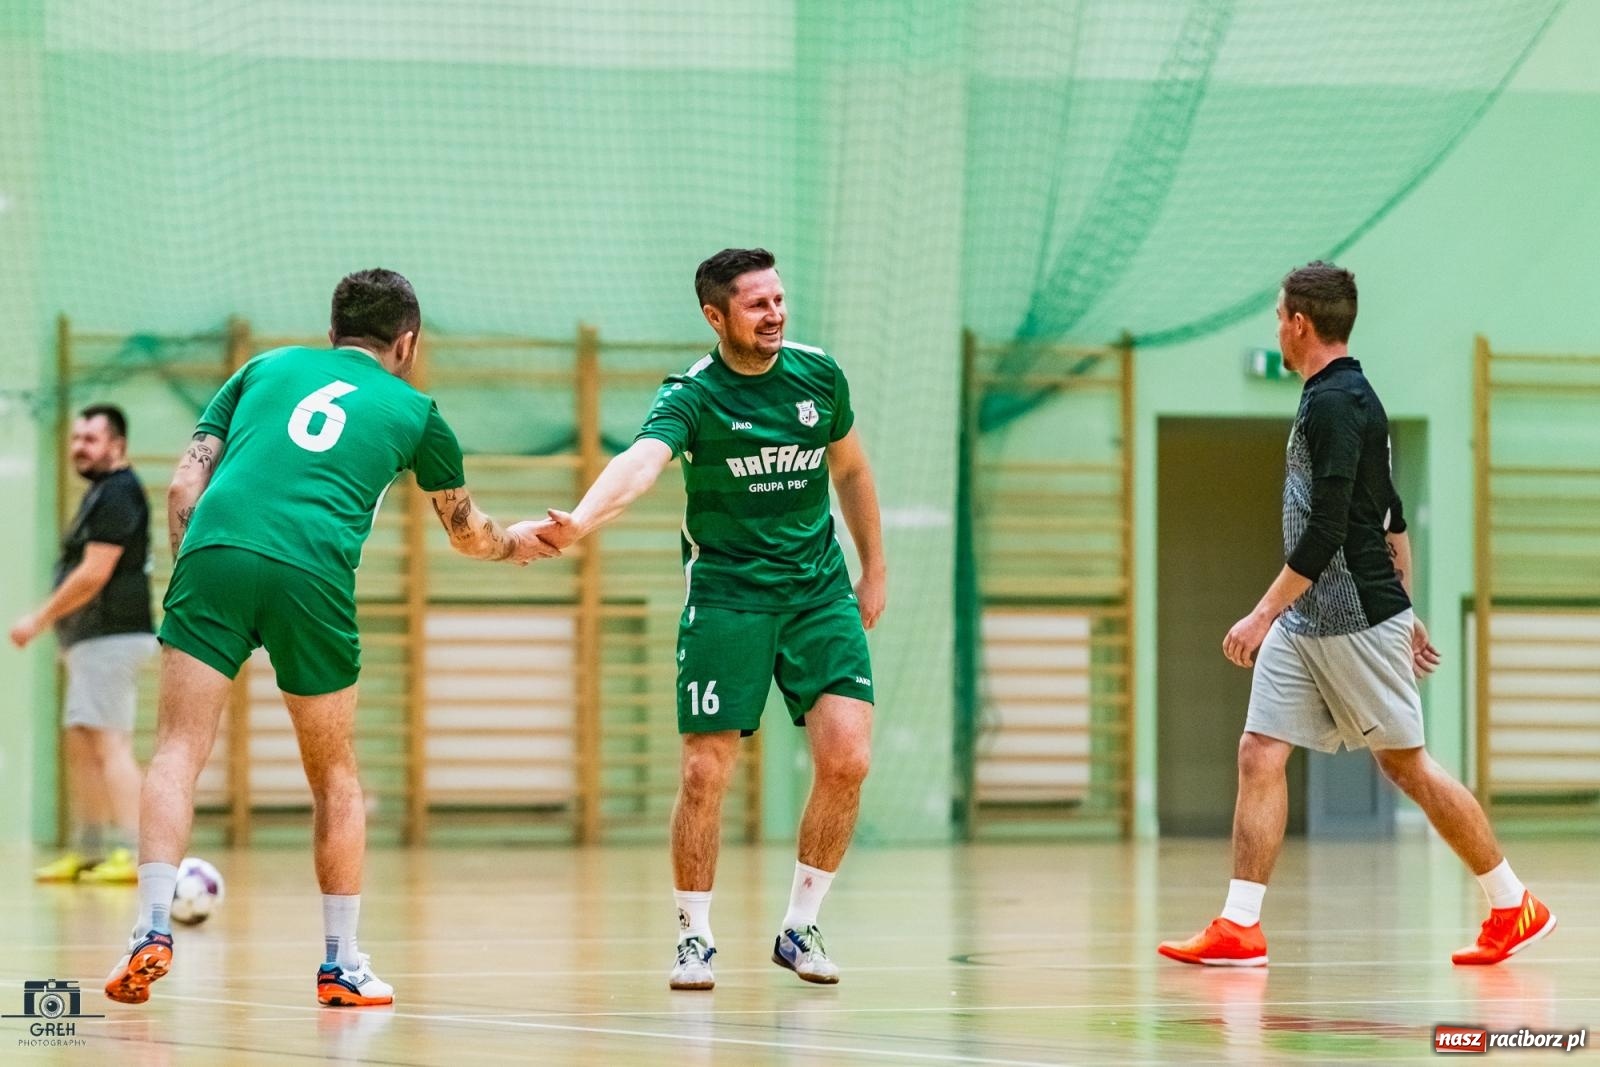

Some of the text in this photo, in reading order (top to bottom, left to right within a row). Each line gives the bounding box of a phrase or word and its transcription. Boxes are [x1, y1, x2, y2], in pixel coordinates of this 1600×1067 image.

[287, 379, 359, 453] 6
[731, 421, 753, 431] JAKO
[725, 444, 827, 478] RAFAKO
[748, 481, 784, 493] GRUPA
[687, 680, 720, 716] 16
